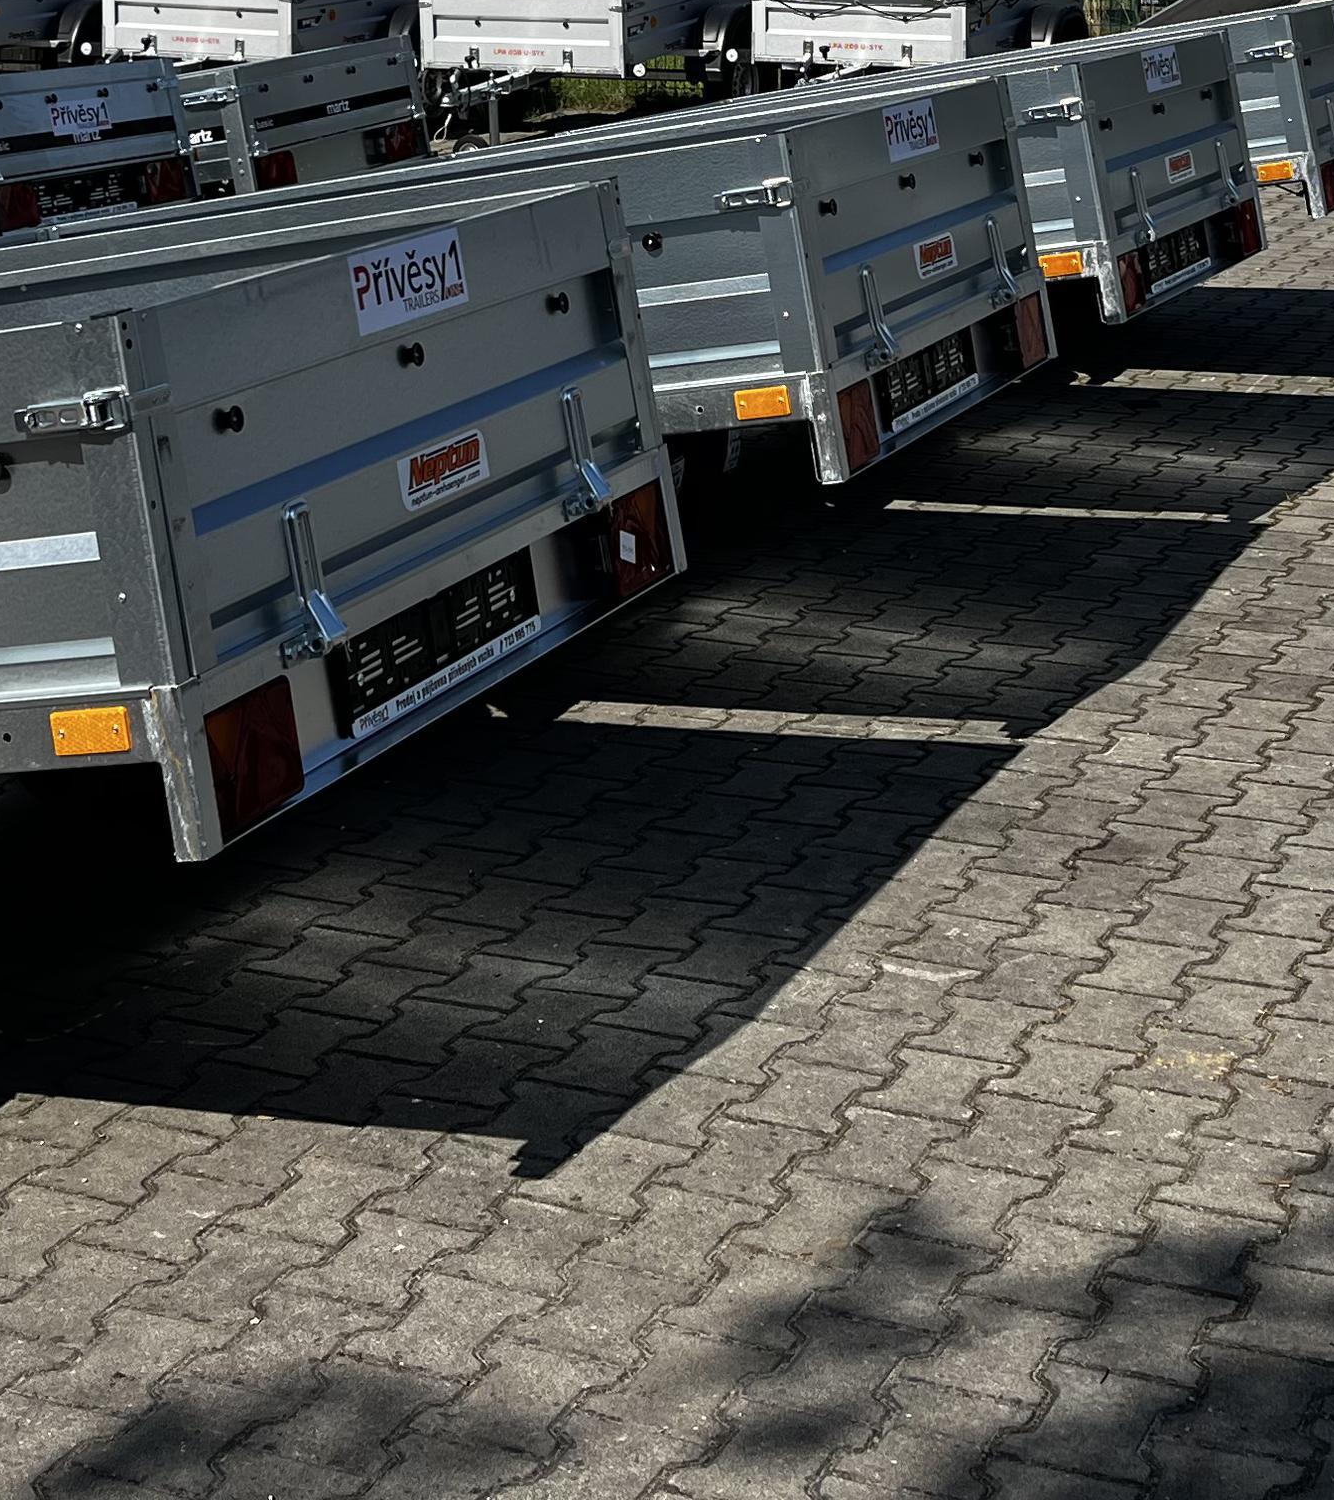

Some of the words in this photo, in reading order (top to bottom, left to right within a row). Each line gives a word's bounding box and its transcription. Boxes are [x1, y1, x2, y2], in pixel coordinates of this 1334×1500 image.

[50, 101, 109, 127] Přívěsy1
[326, 100, 351, 116] martz
[189, 129, 214, 145] artz
[884, 106, 937, 147] Přívěsy1
[353, 239, 463, 311] Přívěsy1
[403, 289, 441, 313] TRAILERS
[408, 437, 481, 491] Neptun
